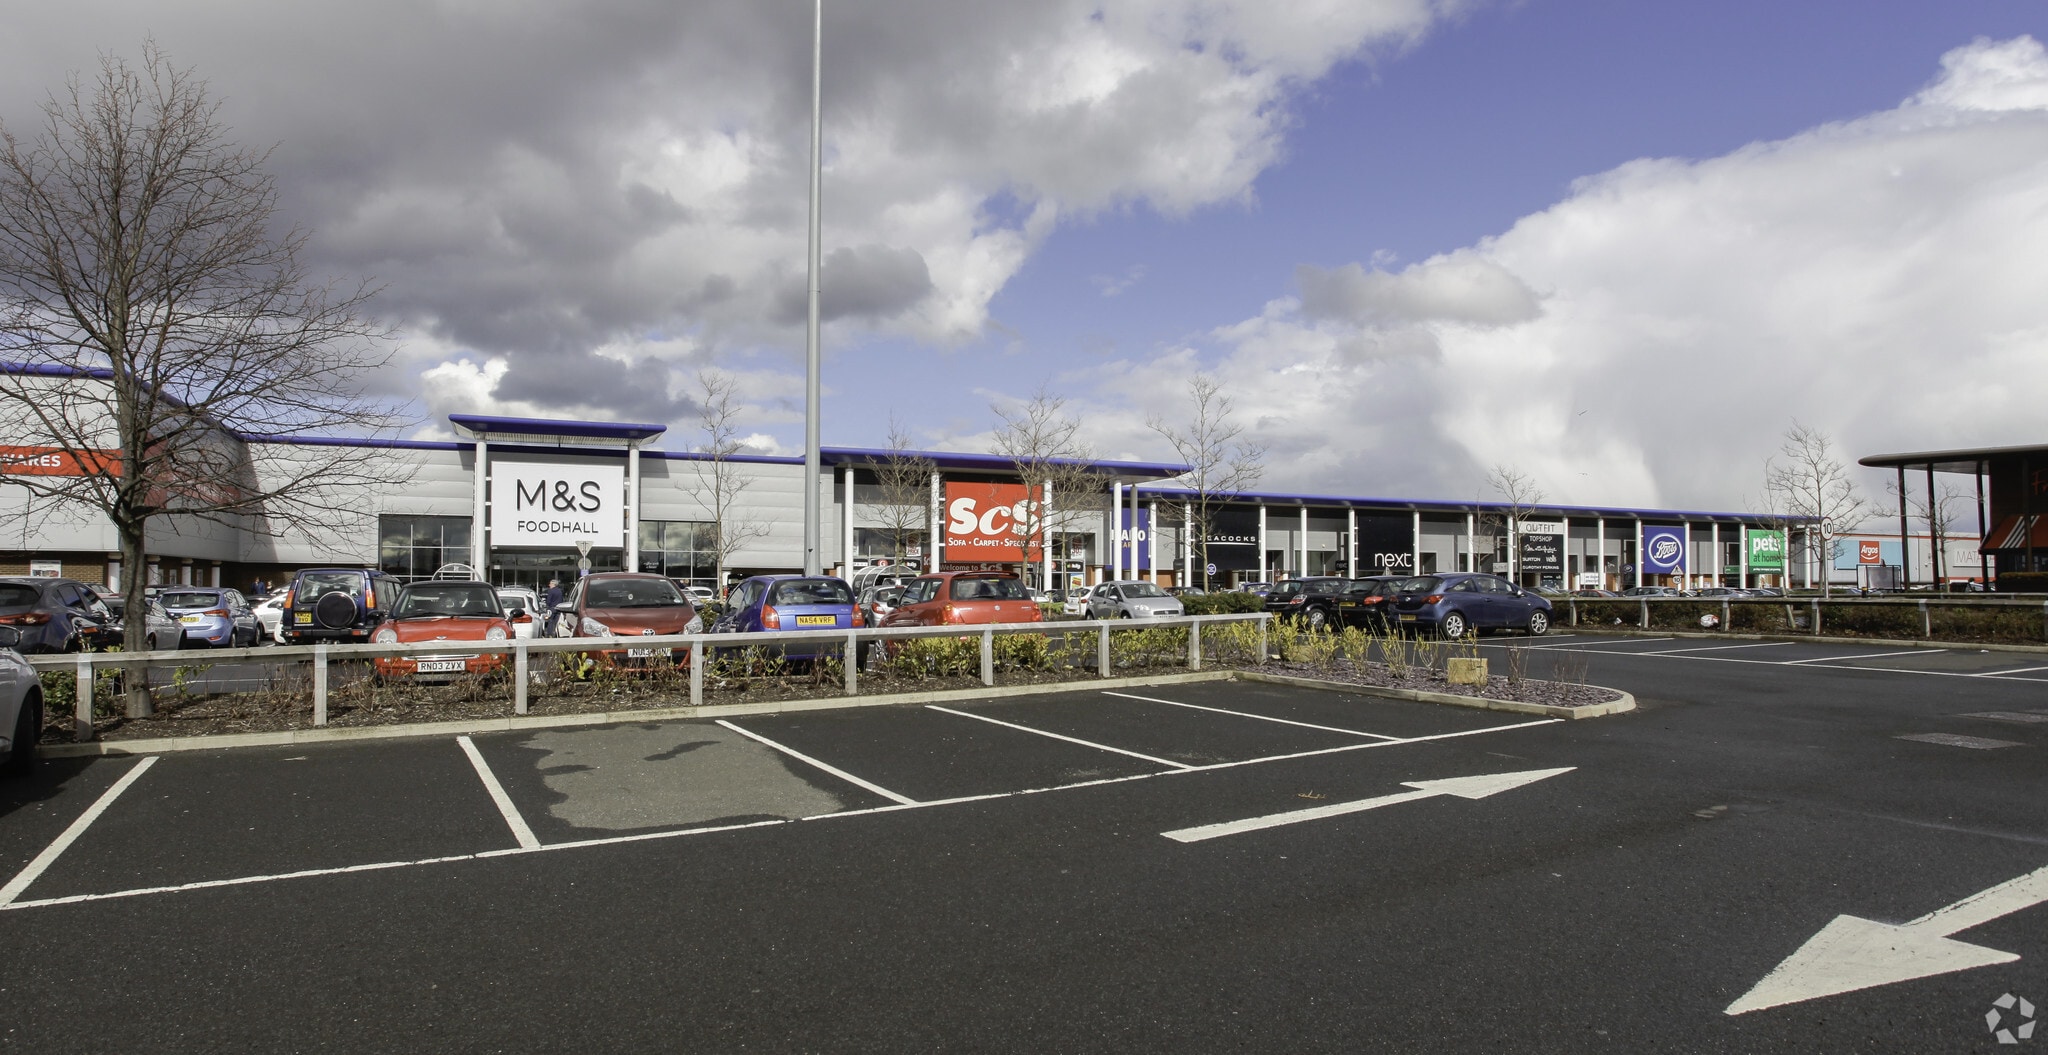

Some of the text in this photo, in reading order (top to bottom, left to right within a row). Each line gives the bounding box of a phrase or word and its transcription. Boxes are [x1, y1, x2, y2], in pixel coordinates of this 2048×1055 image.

[516, 479, 601, 513] M&S
[948, 497, 1040, 536] ScS
[517, 520, 599, 533] FOODHALL
[1525, 523, 1555, 532] OUTFIT
[1823, 523, 1832, 535] 10
[973, 538, 999, 547] CARPET
[1004, 538, 1039, 547] SPECIST
[1753, 535, 1781, 554] pets
[1654, 541, 1677, 558] Boots
[1861, 545, 1878, 556] Argos
[1374, 552, 1412, 567] next
[1753, 553, 1781, 562] at home
[421, 661, 462, 670] RN03 ZVX
